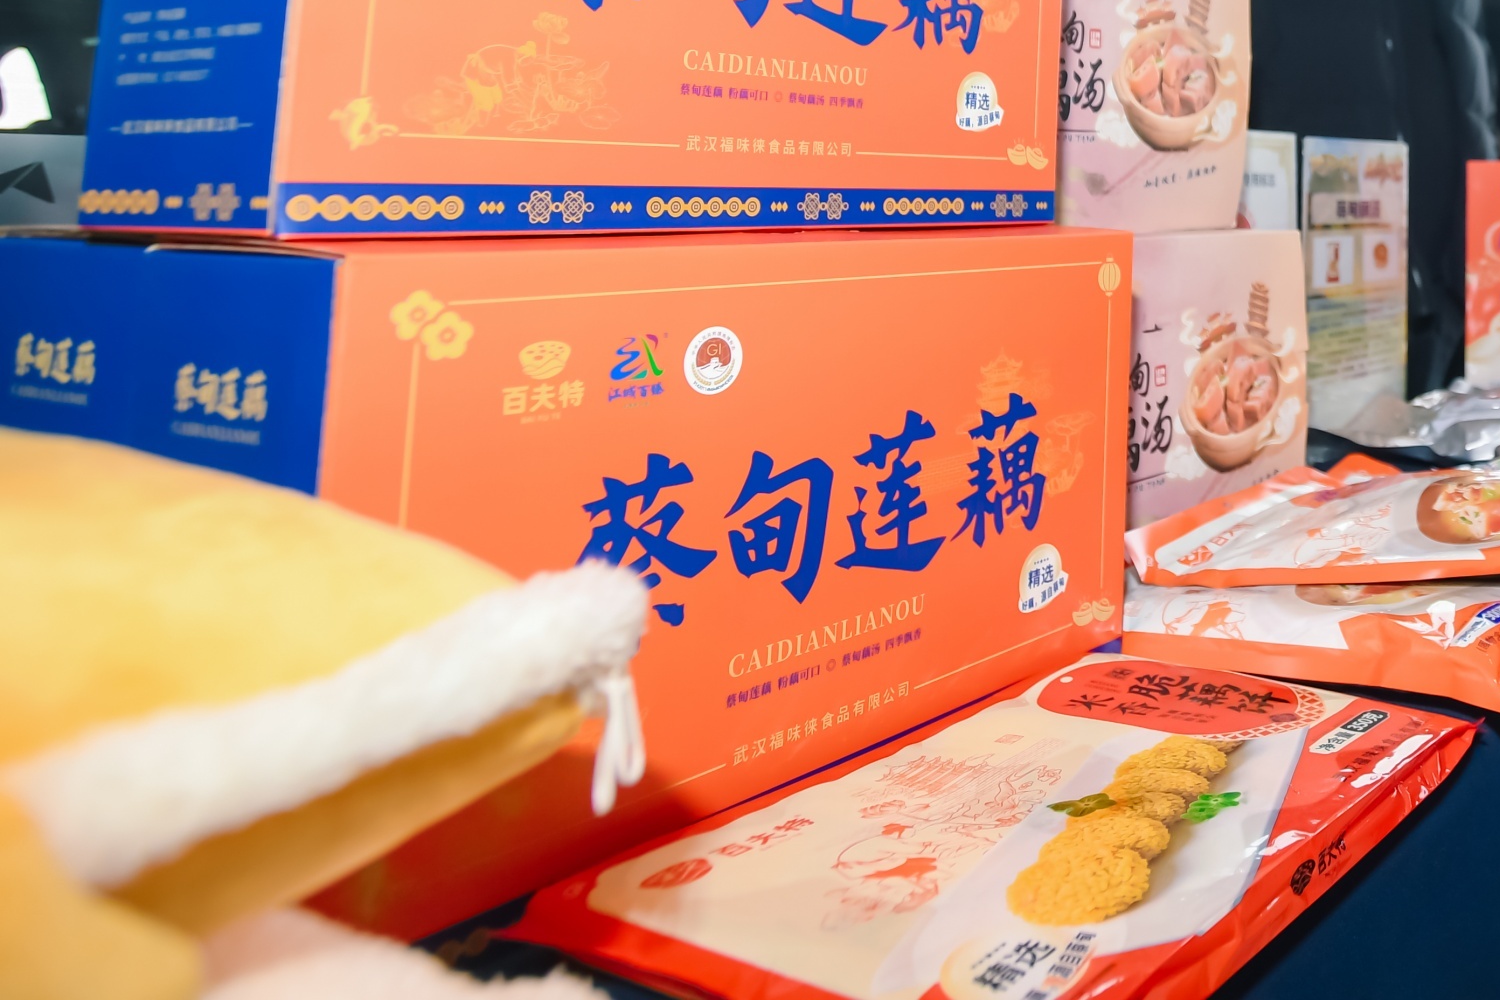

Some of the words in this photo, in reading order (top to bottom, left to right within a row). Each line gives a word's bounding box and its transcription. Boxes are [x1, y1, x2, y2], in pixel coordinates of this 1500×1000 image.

[683, 49, 868, 86] CAIDIANLIANOU
[680, 83, 723, 99] 蔡甸莲藕
[965, 91, 990, 111] 精选
[686, 135, 852, 157] 武汉福味徕食品有限公司
[707, 343, 722, 356] GI
[502, 380, 586, 415] 百夫特
[575, 393, 1046, 627] 蔡甸莲藕
[1028, 563, 1054, 589] 精选
[728, 593, 926, 679] CAIDIANLIANOU
[726, 680, 772, 708] 蔡甸莲藕
[732, 681, 910, 767] 武汉福味徕食品有限公司
[1316, 731, 1355, 752] 净含量
[1347, 711, 1384, 732] 350克
[709, 817, 815, 857] 百夫特
[973, 940, 1056, 991] 精选
